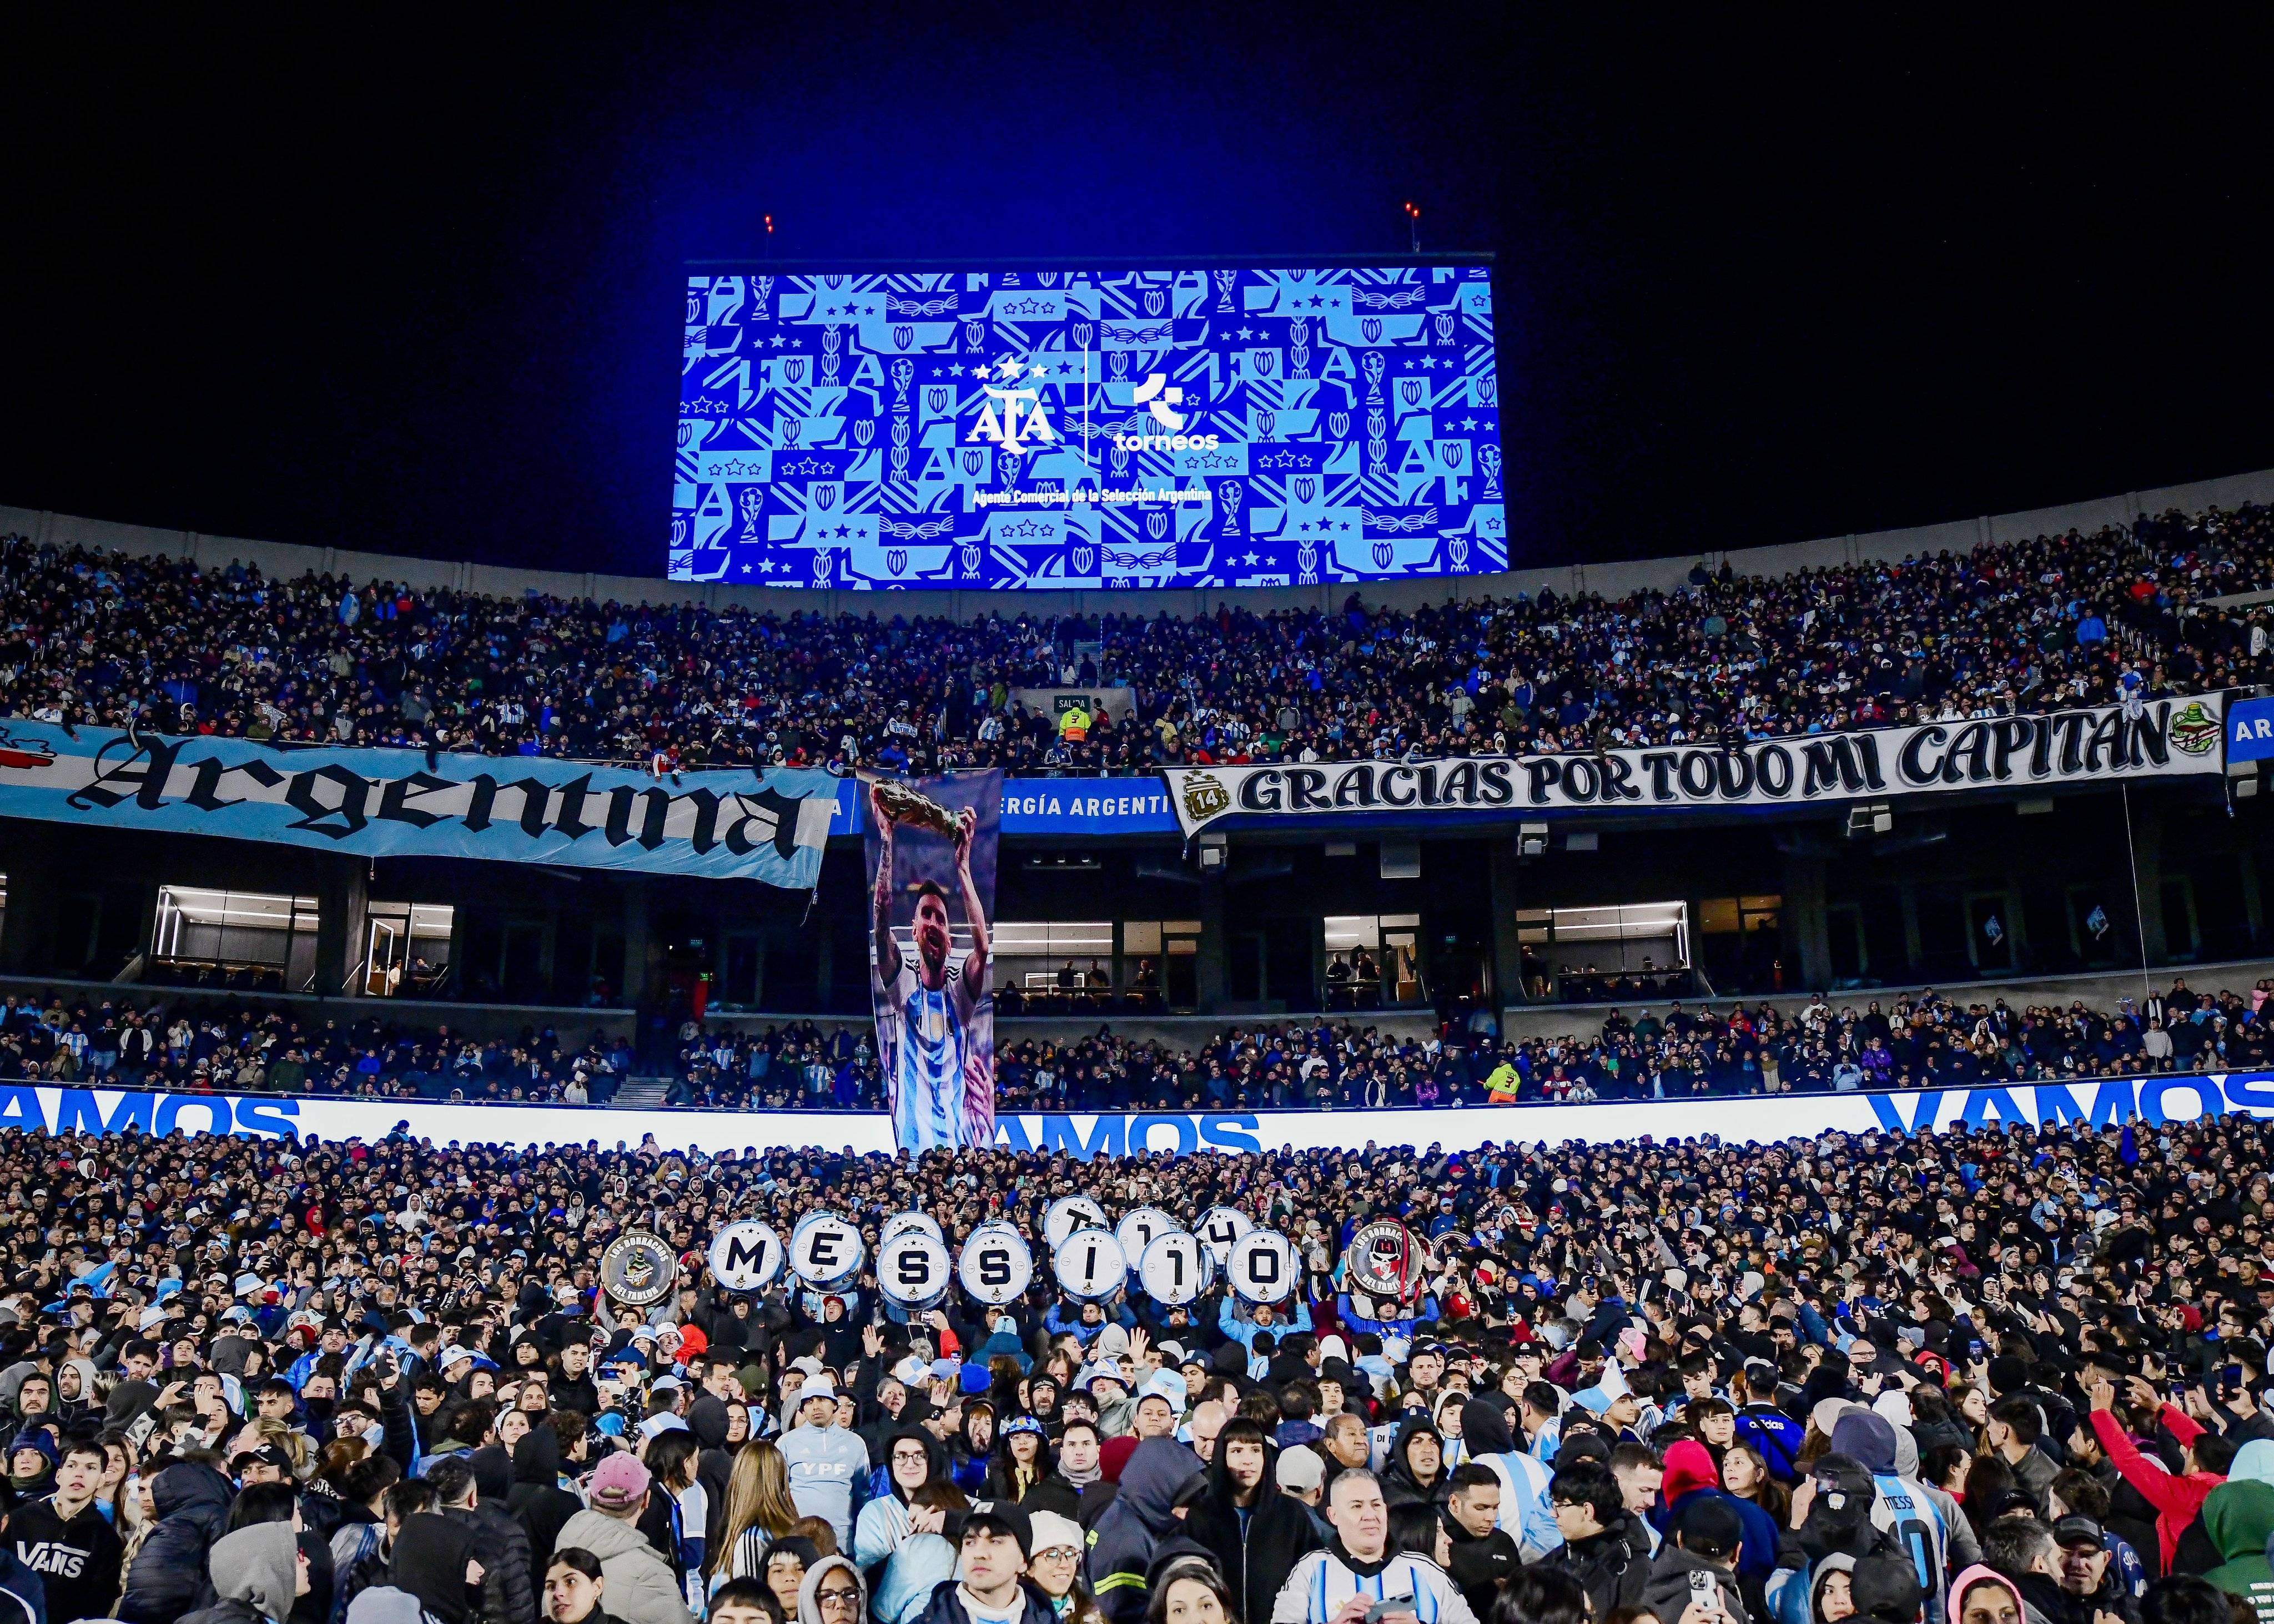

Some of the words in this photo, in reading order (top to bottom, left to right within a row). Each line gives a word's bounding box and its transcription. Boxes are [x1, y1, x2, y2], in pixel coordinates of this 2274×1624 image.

[965, 384, 1056, 454] AFA
[1113, 432, 1219, 452] torneos
[972, 491, 1011, 507] Agente
[1013, 490, 1069, 503] Comercial
[1072, 490, 1086, 503] de
[1088, 489, 1099, 503] la
[1101, 488, 1155, 502] Selección
[1158, 487, 1212, 504] Argentina
[1059, 699, 1085, 708] SALA
[1071, 715, 1080, 724] 3
[1237, 760, 1513, 813] GRACIAS
[1523, 755, 1642, 804] POR
[1642, 744, 1794, 801] TODO
[1800, 734, 1887, 798] MI
[66, 733, 814, 861] Argentina
[1069, 795, 1169, 816] ARGENTI
[1196, 789, 1219, 809] 14
[1505, 1076, 1515, 1088] 3
[994, 1114, 1261, 1161] AMOS
[1355, 1234, 1369, 1249] LOS
[1367, 1227, 1415, 1251] BORRAC
[609, 1243, 624, 1259] LOS
[623, 1237, 669, 1262] BORRACHOS
[612, 1283, 627, 1297] DEL
[627, 1285, 659, 1300] TABLON
[1361, 1274, 1376, 1288] DEL
[1377, 1277, 1408, 1292] TABLO
[1377, 1434, 1385, 1443] DI
[802, 1462, 846, 1475] YPF
[1883, 1496, 1915, 1511] MESSI
[17, 1541, 90, 1578] VANS
